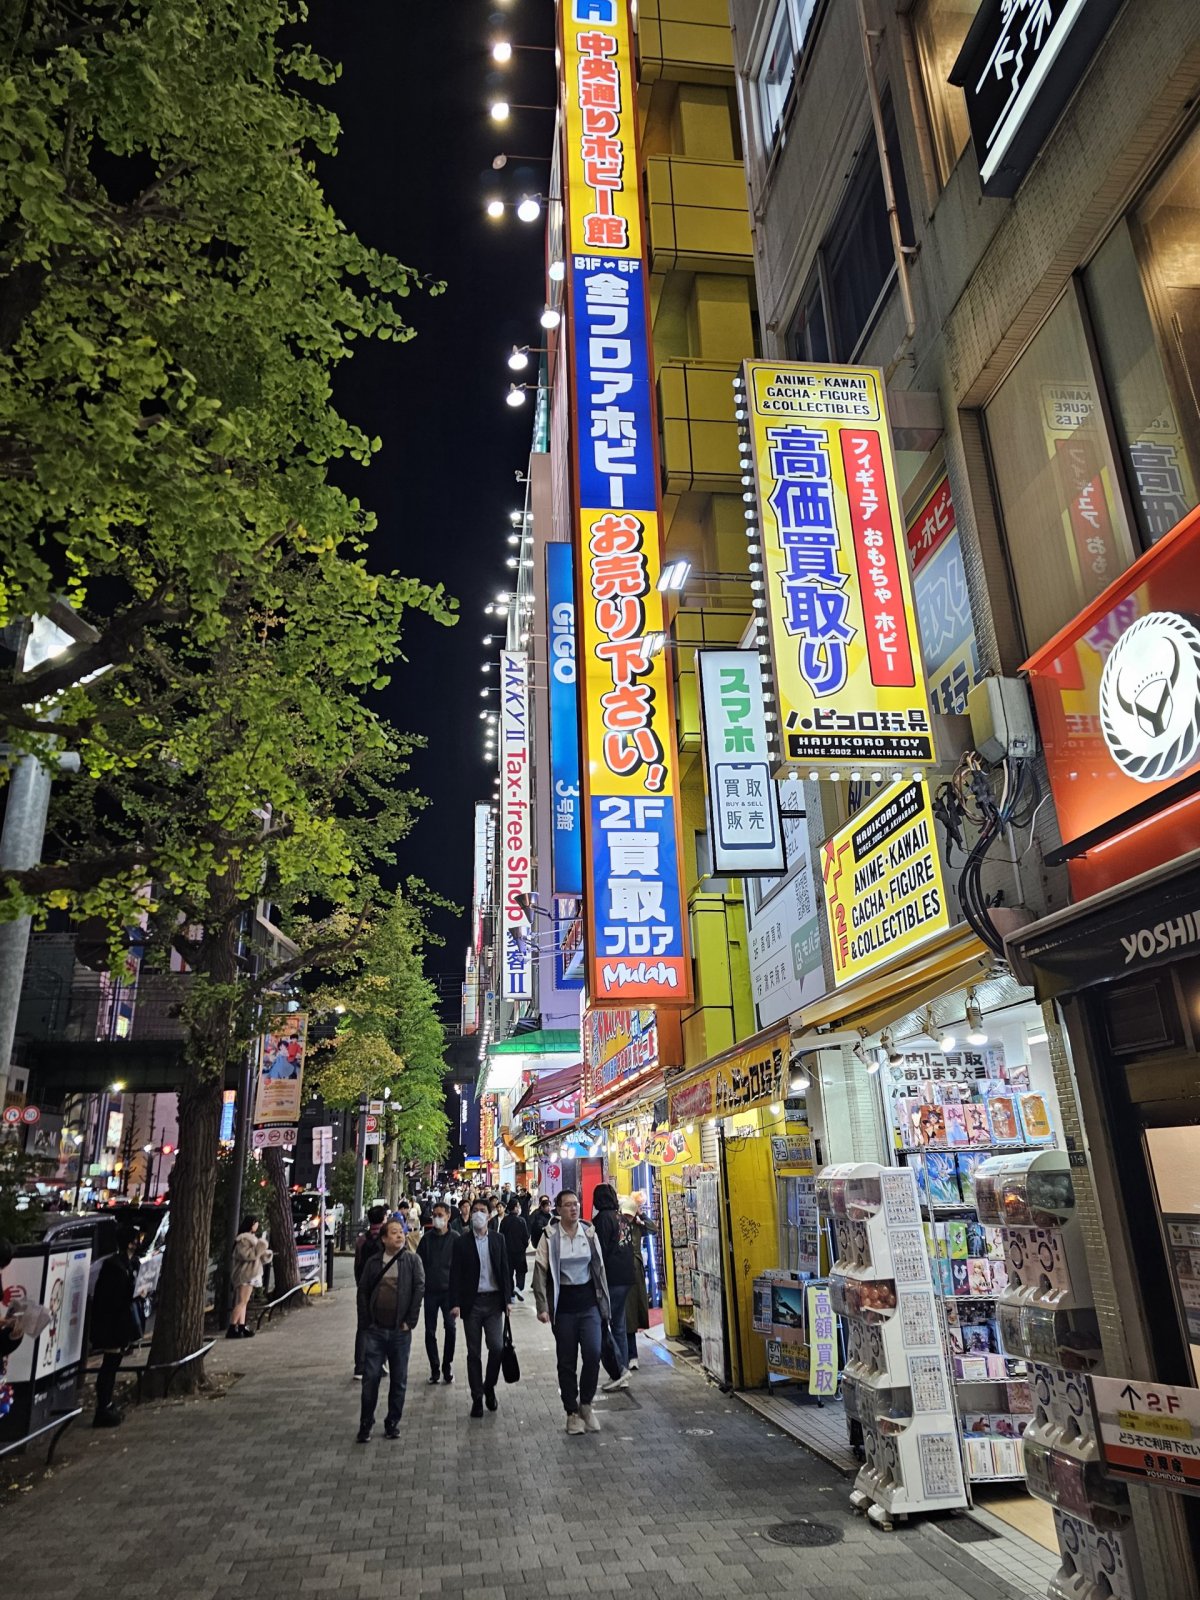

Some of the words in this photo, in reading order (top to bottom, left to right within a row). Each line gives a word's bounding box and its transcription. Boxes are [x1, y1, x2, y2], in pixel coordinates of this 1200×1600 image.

[577, 32, 628, 247] 中央通りホビー館
[584, 272, 638, 508] 全フロアホビー
[766, 387, 811, 399] GACHA
[819, 390, 867, 402] FIGURE
[774, 374, 816, 387] ANIME
[824, 377, 867, 389] KAWAII
[851, 437, 879, 521] フィギュア
[766, 423, 858, 699] 高価買取り
[863, 527, 893, 605] おもちゃ
[591, 513, 662, 794] お売り下さい！
[874, 612, 898, 671] ホビー
[505, 655, 525, 726] AKKY
[719, 668, 755, 753] スマホ
[889, 738, 920, 748] TOY
[507, 747, 527, 852] Tax-free
[600, 797, 665, 829] 2F
[724, 778, 762, 798] 買取
[727, 810, 765, 830] 販売
[898, 786, 918, 808] TOY
[505, 856, 528, 922] Shop
[607, 831, 666, 923] 買取
[851, 889, 886, 929] GACHA
[889, 854, 935, 905] FIGURE
[854, 854, 886, 896] ANIME
[889, 820, 930, 869] KAWAII
[603, 926, 673, 955] フロア
[835, 902, 850, 969] 2F
[602, 961, 679, 992] Mulan
[815, 1292, 833, 1392] 高額買取
[1146, 1392, 1181, 1414] 2F
